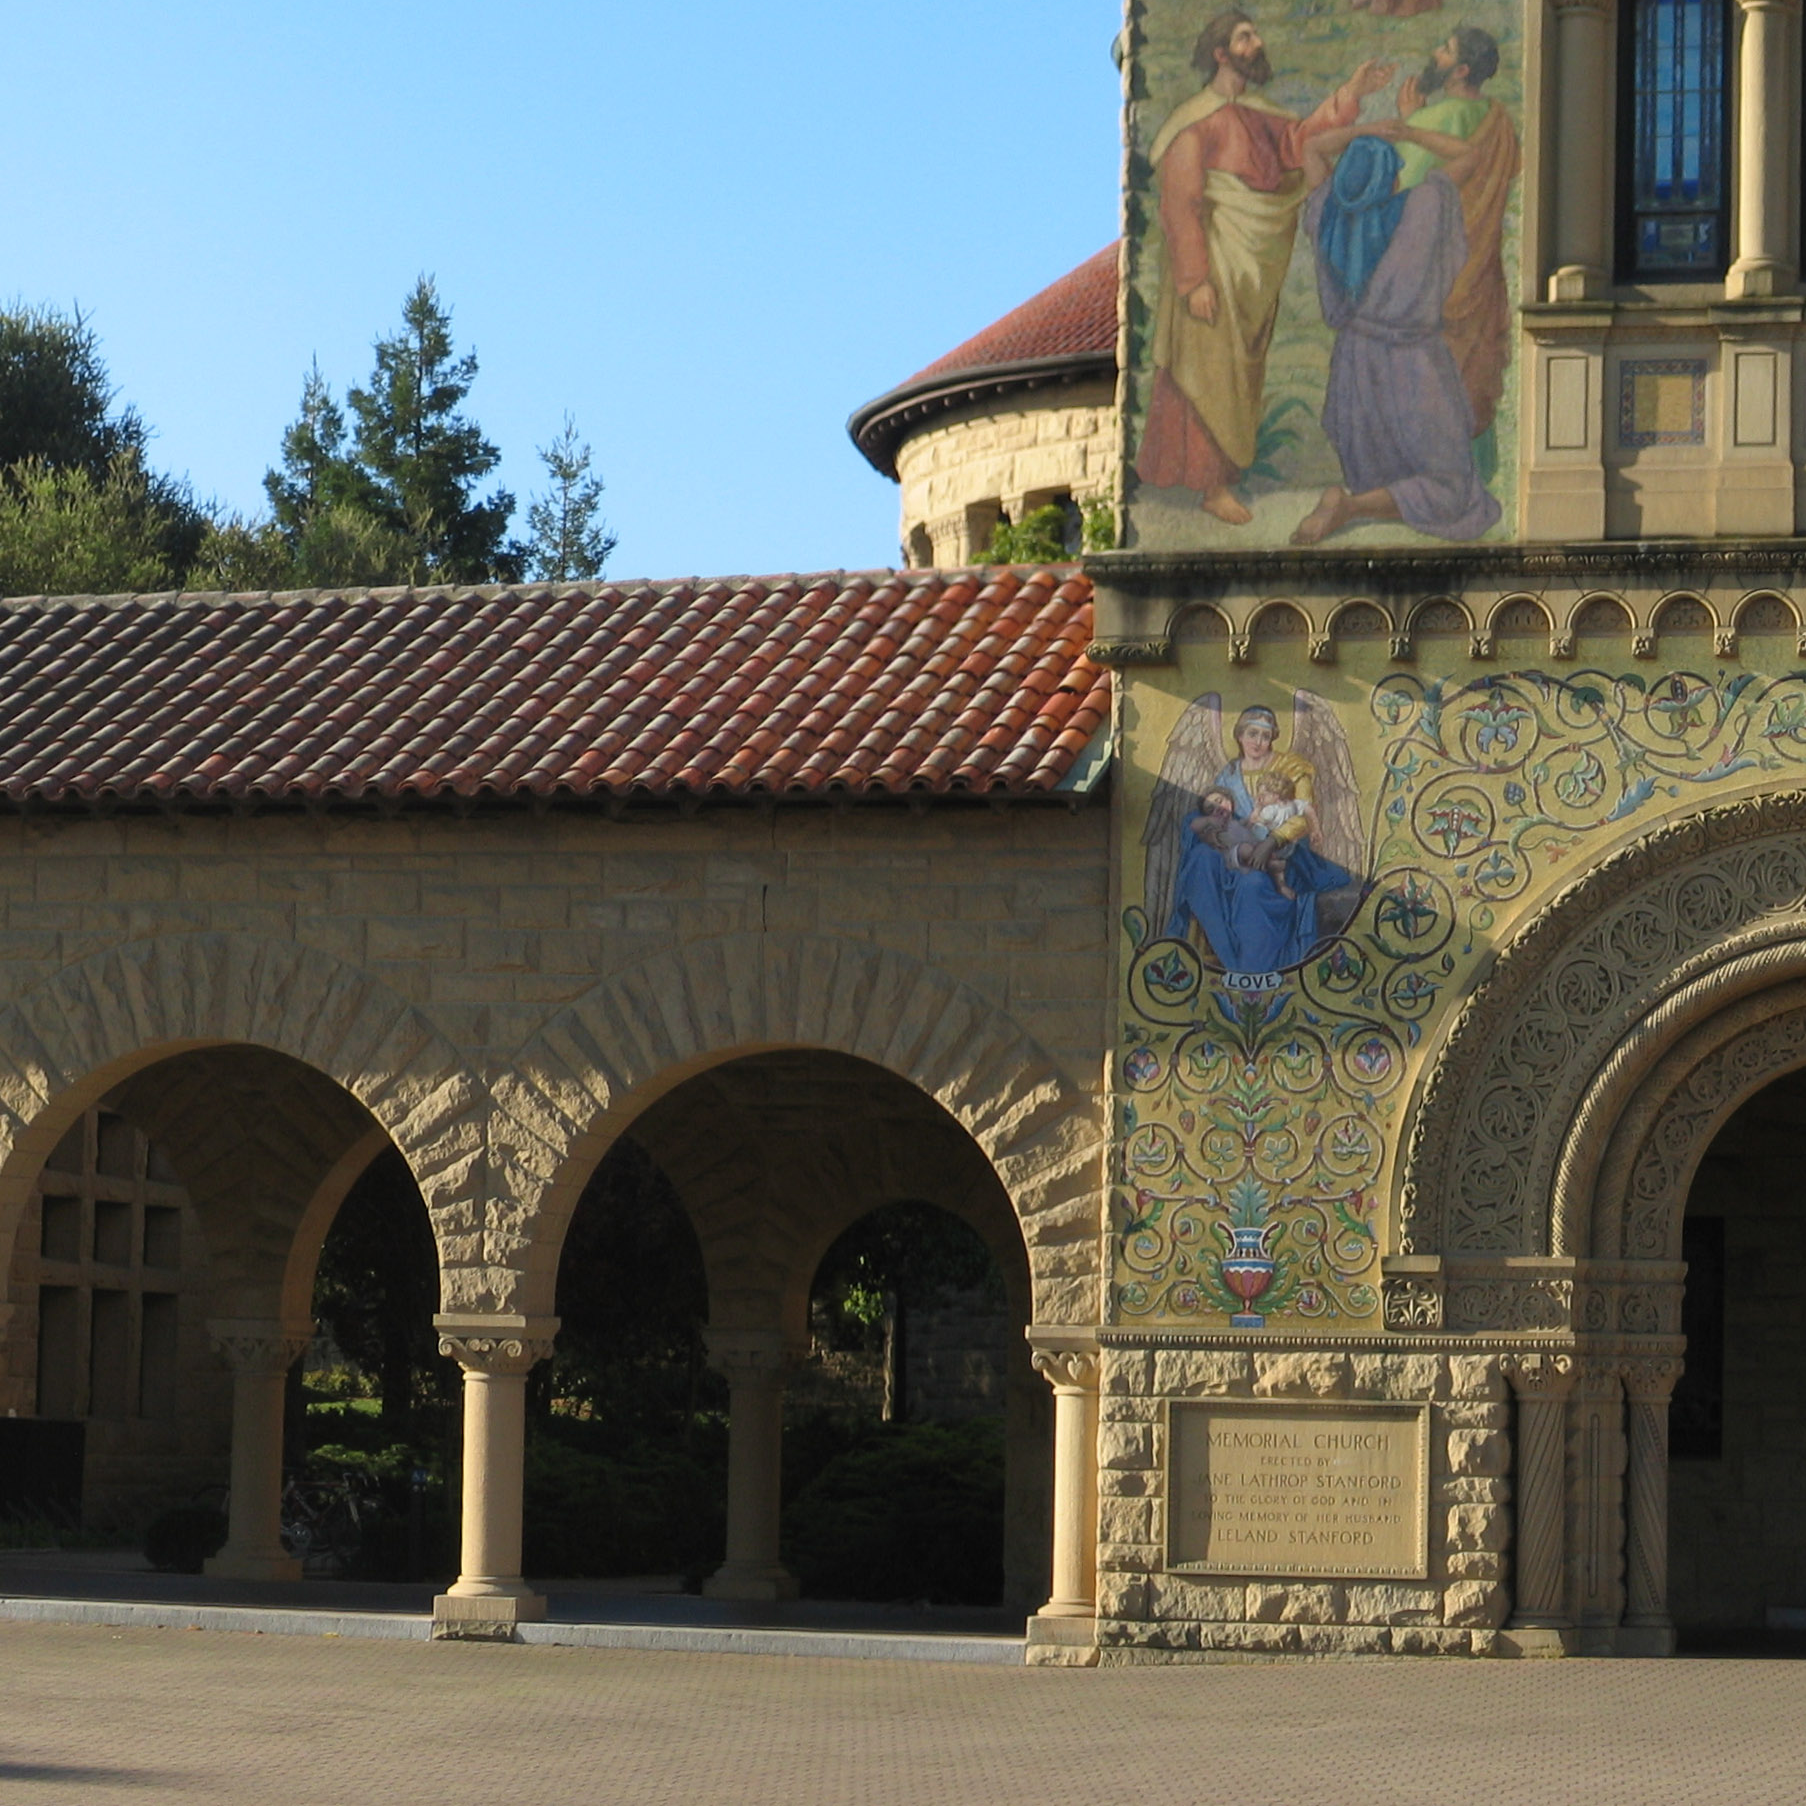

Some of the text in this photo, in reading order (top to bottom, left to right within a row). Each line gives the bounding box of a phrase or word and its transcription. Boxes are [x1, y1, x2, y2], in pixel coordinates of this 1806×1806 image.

[1228, 974, 1276, 988] LOVE
[1207, 1432, 1390, 1451] MEMORIAL CHURCH
[1261, 1456, 1331, 1467] ERECTED BY
[1241, 1474, 1308, 1488] LATHROP
[1316, 1475, 1402, 1490] STANFORD
[1225, 1494, 1245, 1505] THE
[1250, 1495, 1287, 1506] GLORY
[1293, 1495, 1305, 1506] OF
[1311, 1496, 1336, 1506] GOD
[1342, 1496, 1369, 1507] AND
[1378, 1497, 1393, 1507] IN
[1239, 1512, 1290, 1523] MEMORY
[1295, 1512, 1309, 1523] OF
[1317, 1512, 1339, 1524] HER
[1345, 1513, 1401, 1525] HUSBAND
[1218, 1528, 1374, 1546] LELAND STANFORD
